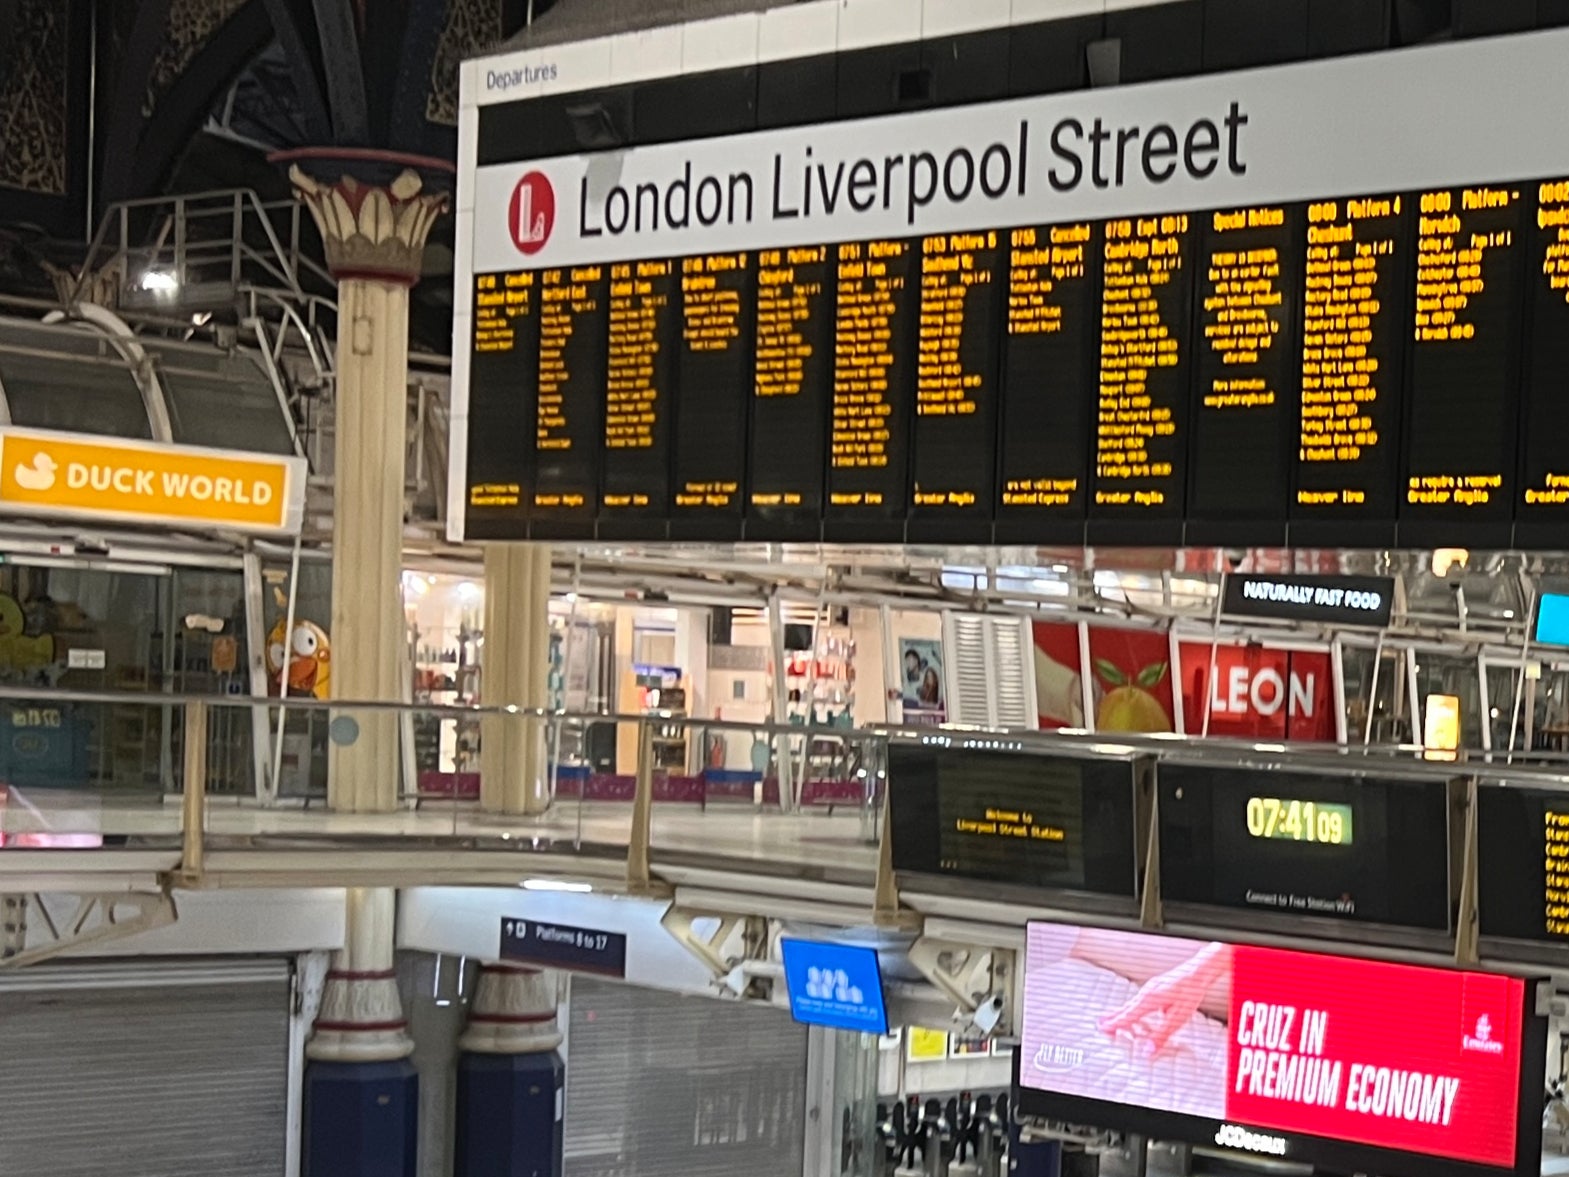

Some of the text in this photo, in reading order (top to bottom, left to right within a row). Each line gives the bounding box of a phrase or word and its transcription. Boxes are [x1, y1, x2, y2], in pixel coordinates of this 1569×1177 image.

[487, 64, 557, 90] Departures
[578, 101, 1249, 240] London Liverpool Street
[1462, 188, 1508, 210] Platform
[1248, 208, 1283, 226] Notices
[66, 462, 273, 506] DUCK WORLD
[1243, 580, 1382, 612] NATURALLY FAST FOOD
[1209, 664, 1316, 718] LEON
[956, 818, 1063, 841] Liverpool Street Station
[1246, 796, 1342, 843] 07:41 09
[1246, 888, 1277, 905] Connect
[1278, 894, 1287, 906] to
[1289, 894, 1306, 908] Free
[1307, 896, 1335, 912] Station
[536, 924, 576, 945] Platforms
[584, 934, 594, 949] to
[1237, 1000, 1328, 1055] CRUZ IN
[1463, 1034, 1504, 1055] Emirates
[1235, 1048, 1460, 1127] PREMIUM ECONOMY
[1215, 1124, 1287, 1156] JCDecaux
